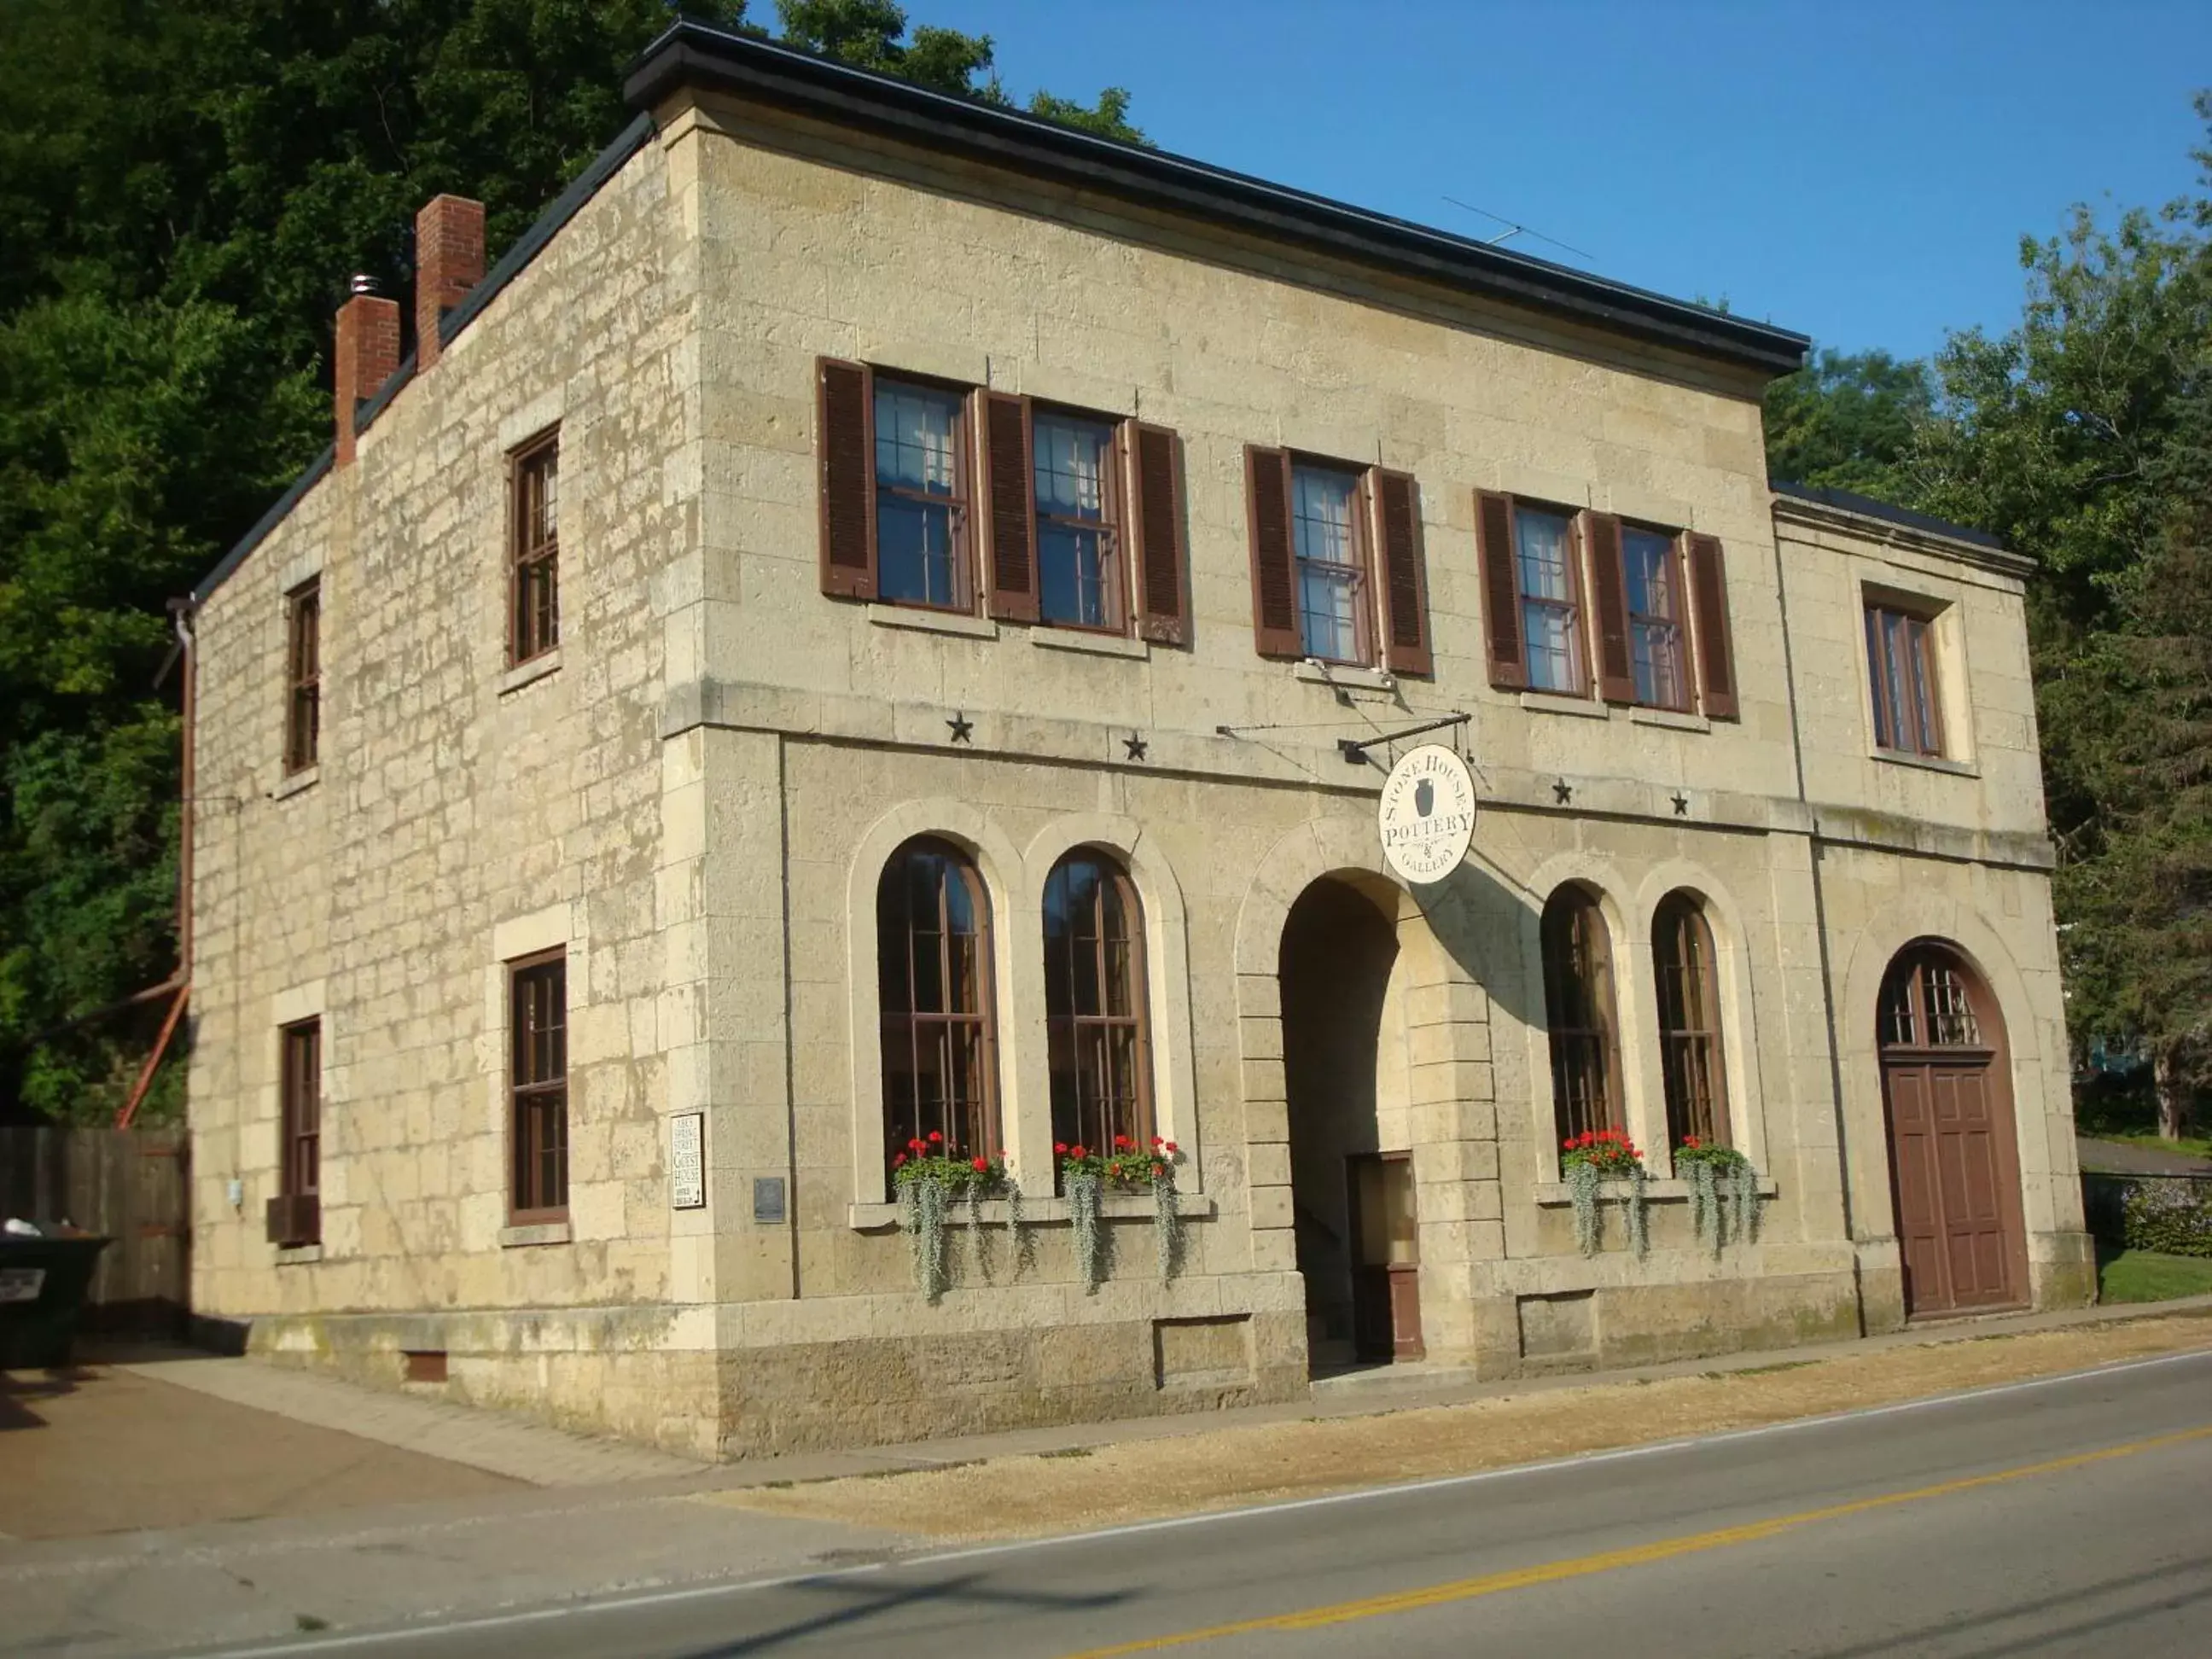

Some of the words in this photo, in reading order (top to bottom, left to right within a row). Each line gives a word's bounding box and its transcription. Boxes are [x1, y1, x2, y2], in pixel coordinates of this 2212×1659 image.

[1385, 760, 1421, 821] STONE
[1426, 754, 1466, 807] HOUSE
[1385, 812, 1471, 847] POTTERY
[1401, 848, 1453, 872] GALLERY
[1423, 845, 1432, 859] &
[674, 1151, 698, 1168] GUEST
